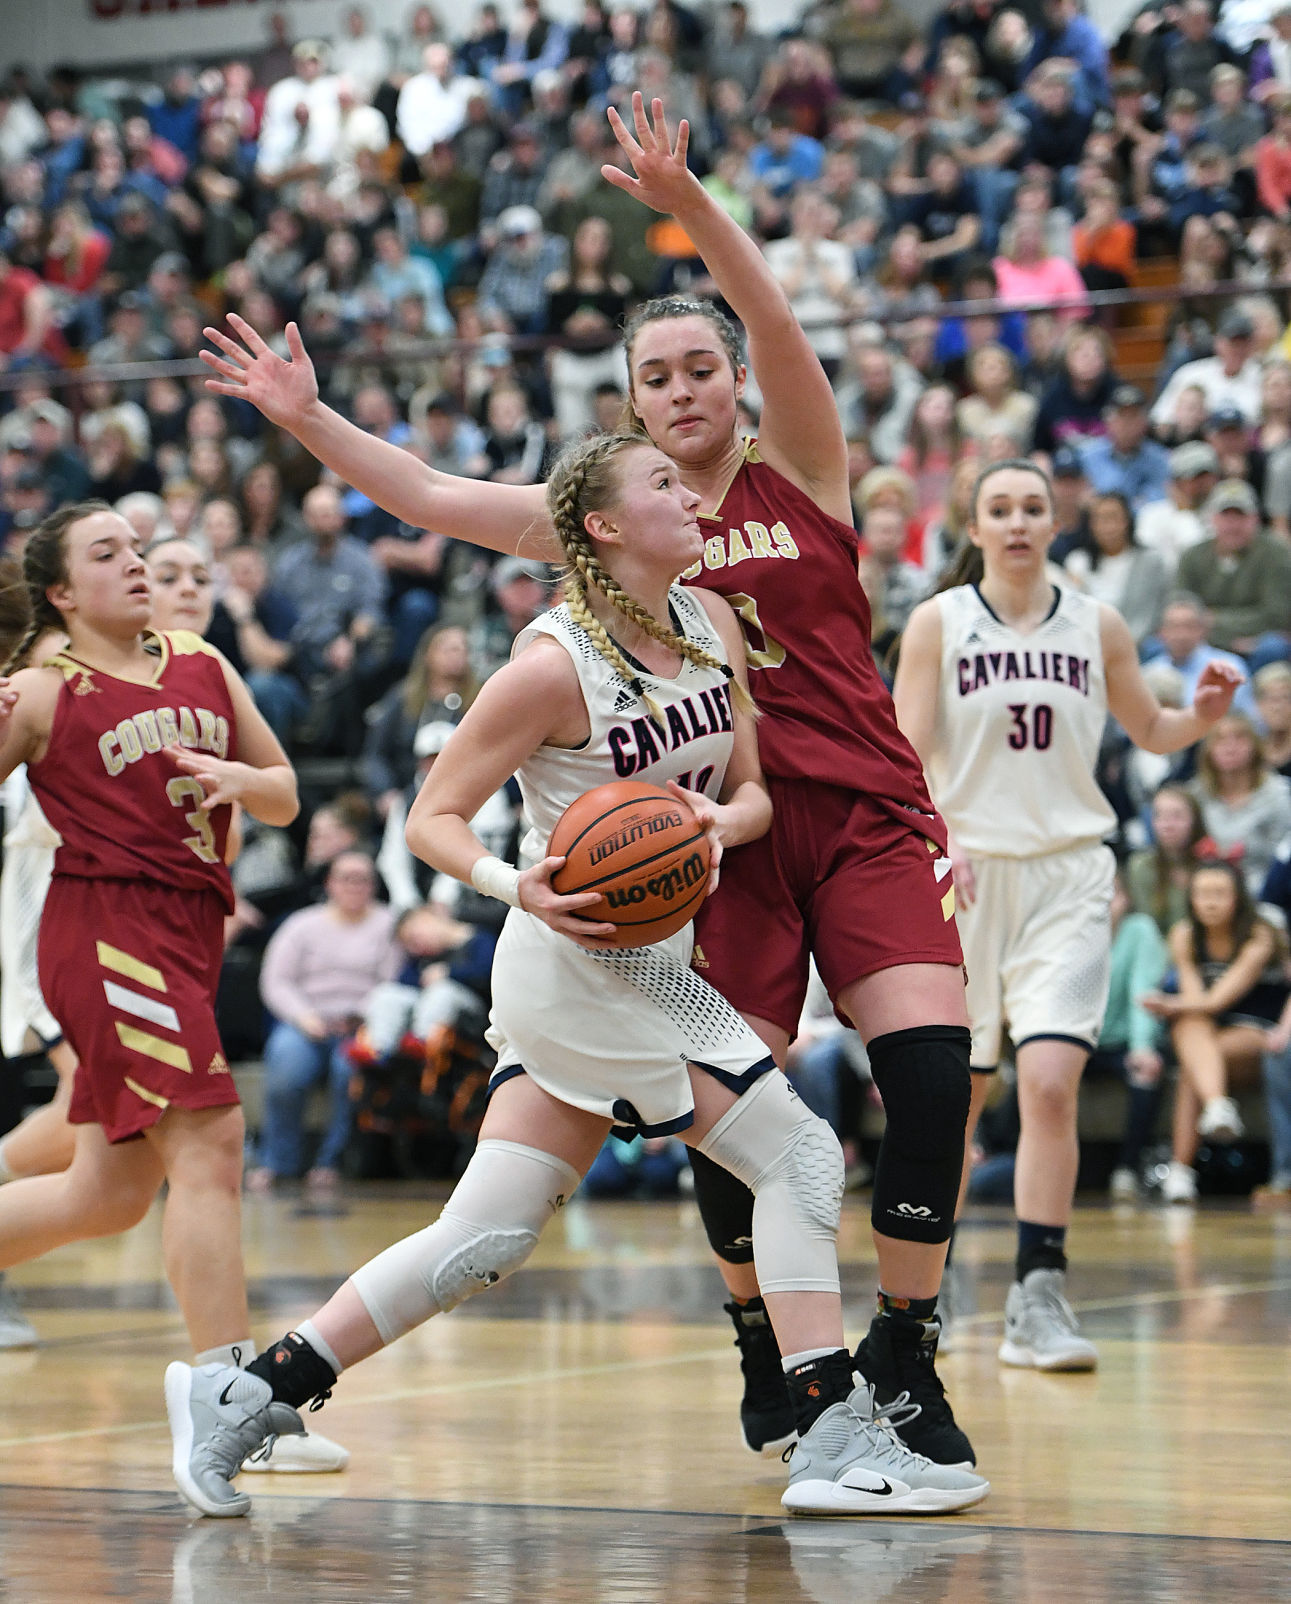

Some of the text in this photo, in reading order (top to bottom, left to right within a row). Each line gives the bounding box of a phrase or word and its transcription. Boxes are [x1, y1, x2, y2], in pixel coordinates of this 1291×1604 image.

[98, 706, 230, 777] COUGARS
[608, 683, 734, 778] CAVALIE
[1007, 704, 1053, 751] 30
[166, 775, 221, 863] 3
[588, 813, 684, 867] EVOLUTION
[604, 852, 706, 909] Wilson
